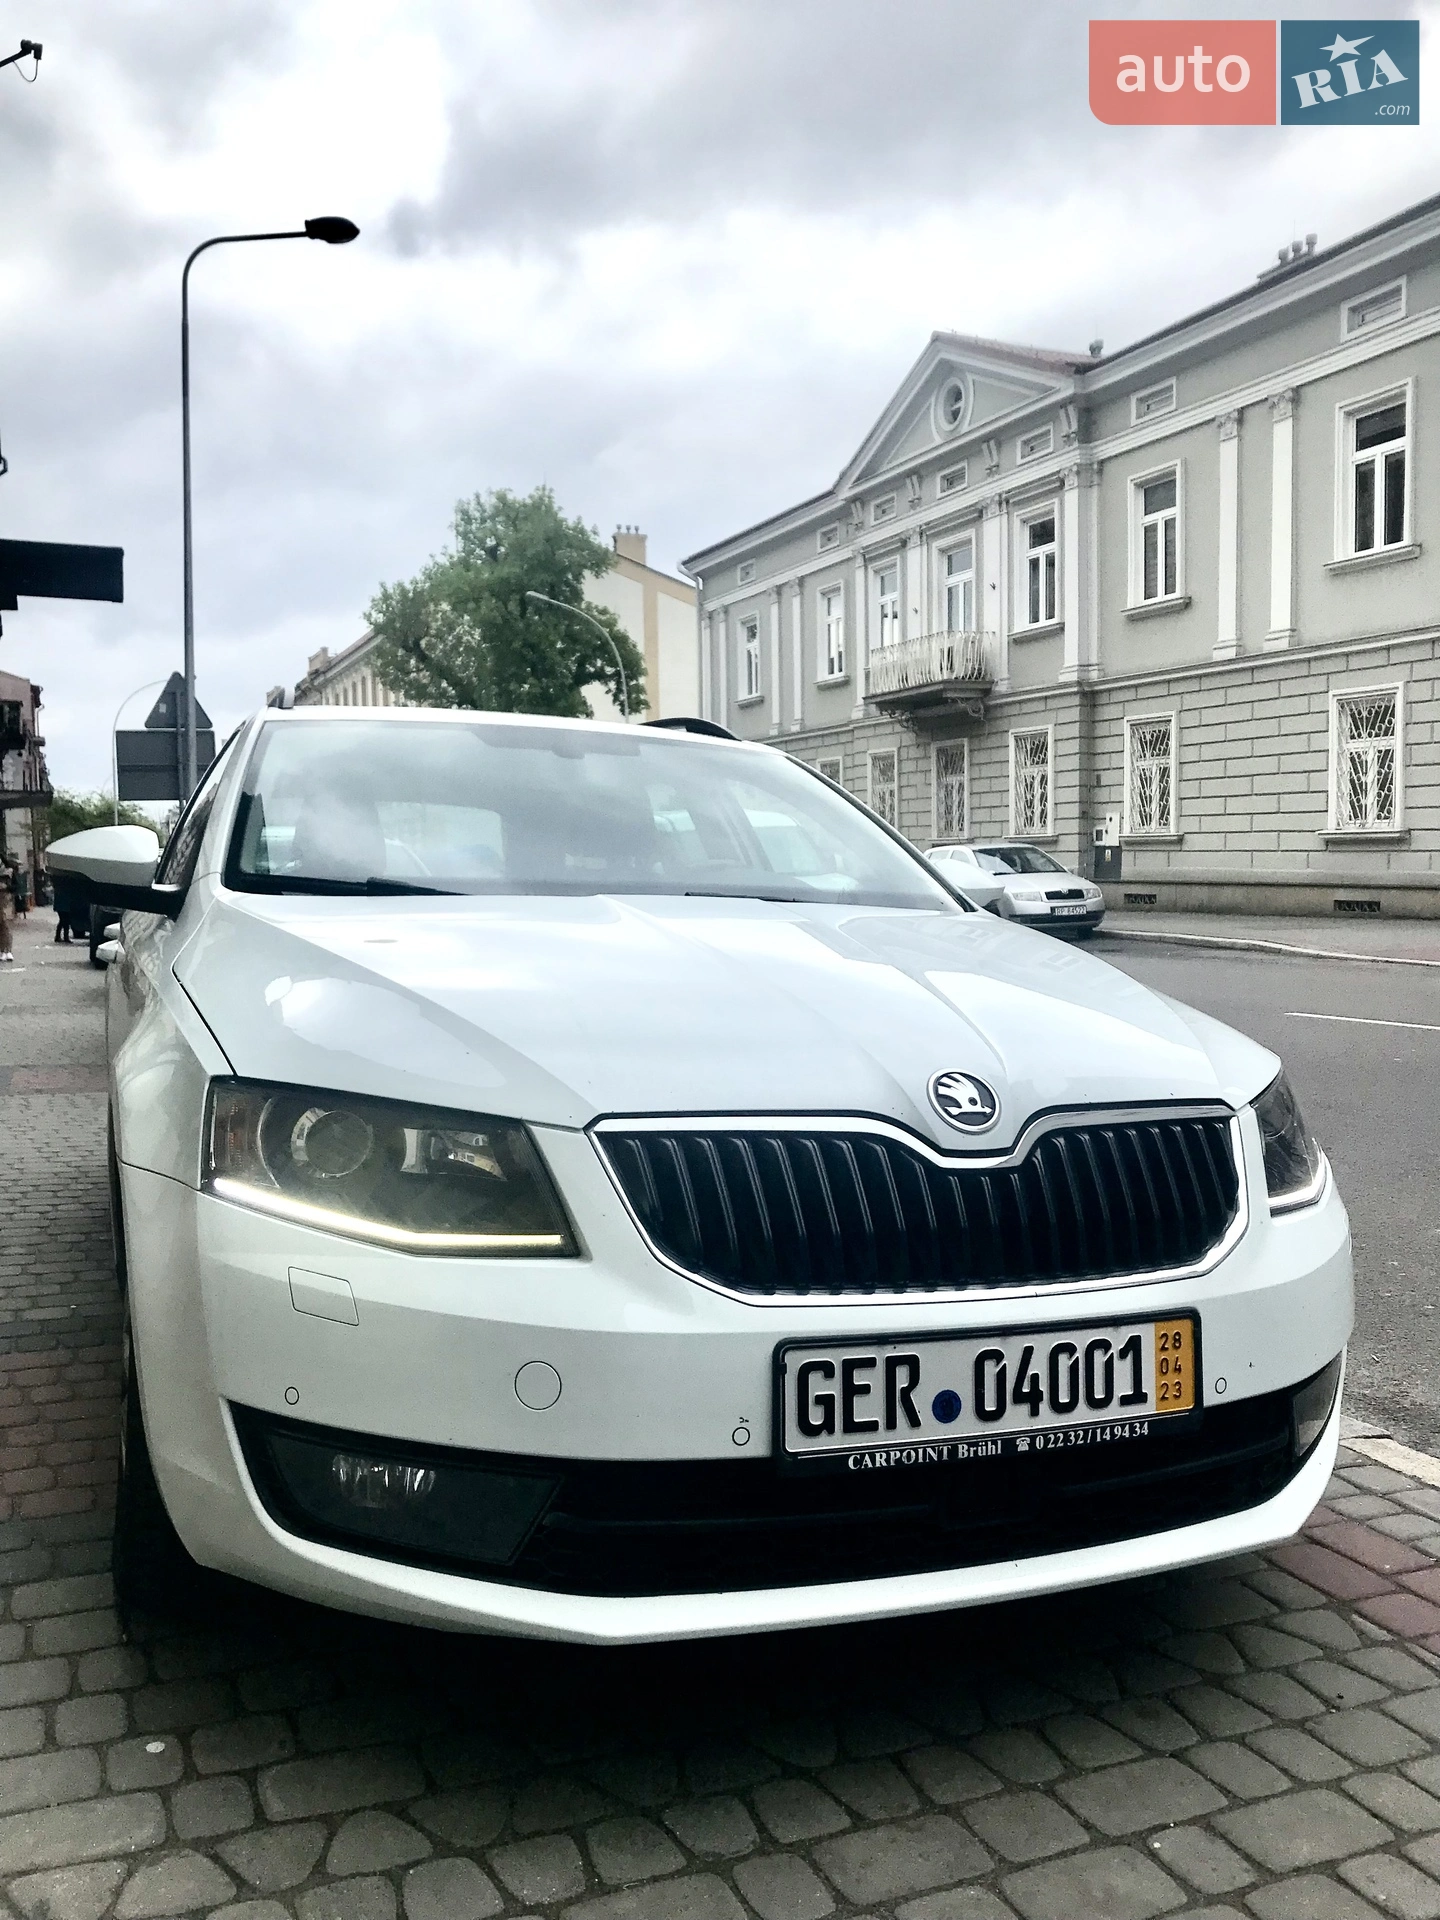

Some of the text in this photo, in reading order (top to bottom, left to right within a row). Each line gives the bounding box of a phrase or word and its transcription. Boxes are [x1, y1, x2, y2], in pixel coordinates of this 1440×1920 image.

[1160, 1331, 1182, 1351] 28
[1160, 1356, 1182, 1375] 04
[797, 1334, 1148, 1438] GER 04001
[1160, 1381, 1182, 1401] 23
[848, 1445, 951, 1470] CARPOINT
[957, 1440, 1002, 1459] Brühl
